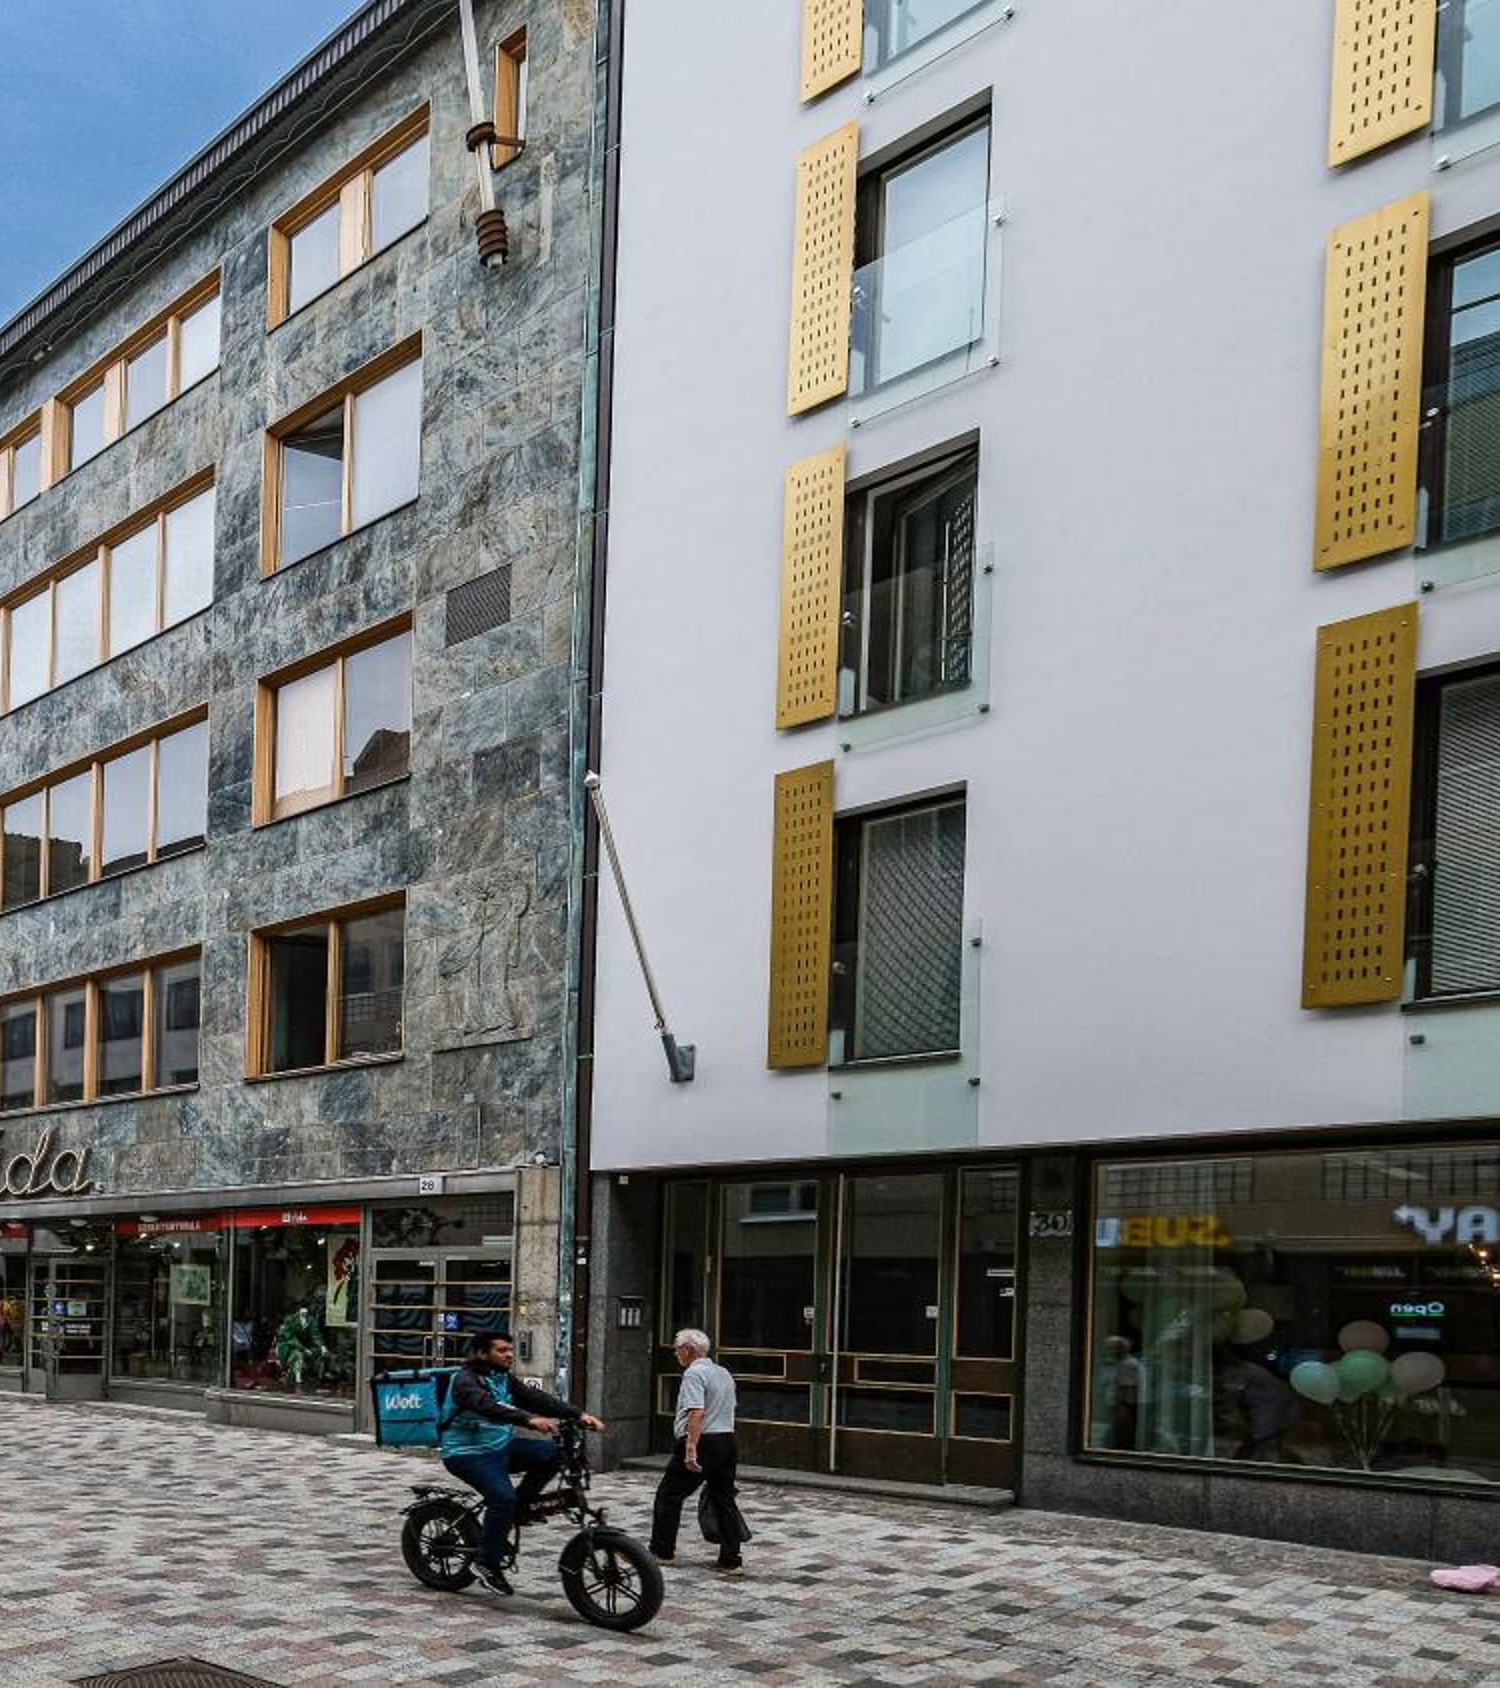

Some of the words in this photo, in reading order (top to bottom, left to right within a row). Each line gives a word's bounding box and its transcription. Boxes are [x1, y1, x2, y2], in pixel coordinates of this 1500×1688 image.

[421, 1179, 435, 1191] 28
[1033, 1214, 1067, 1232] 30
[385, 1391, 421, 1411] Wolt
